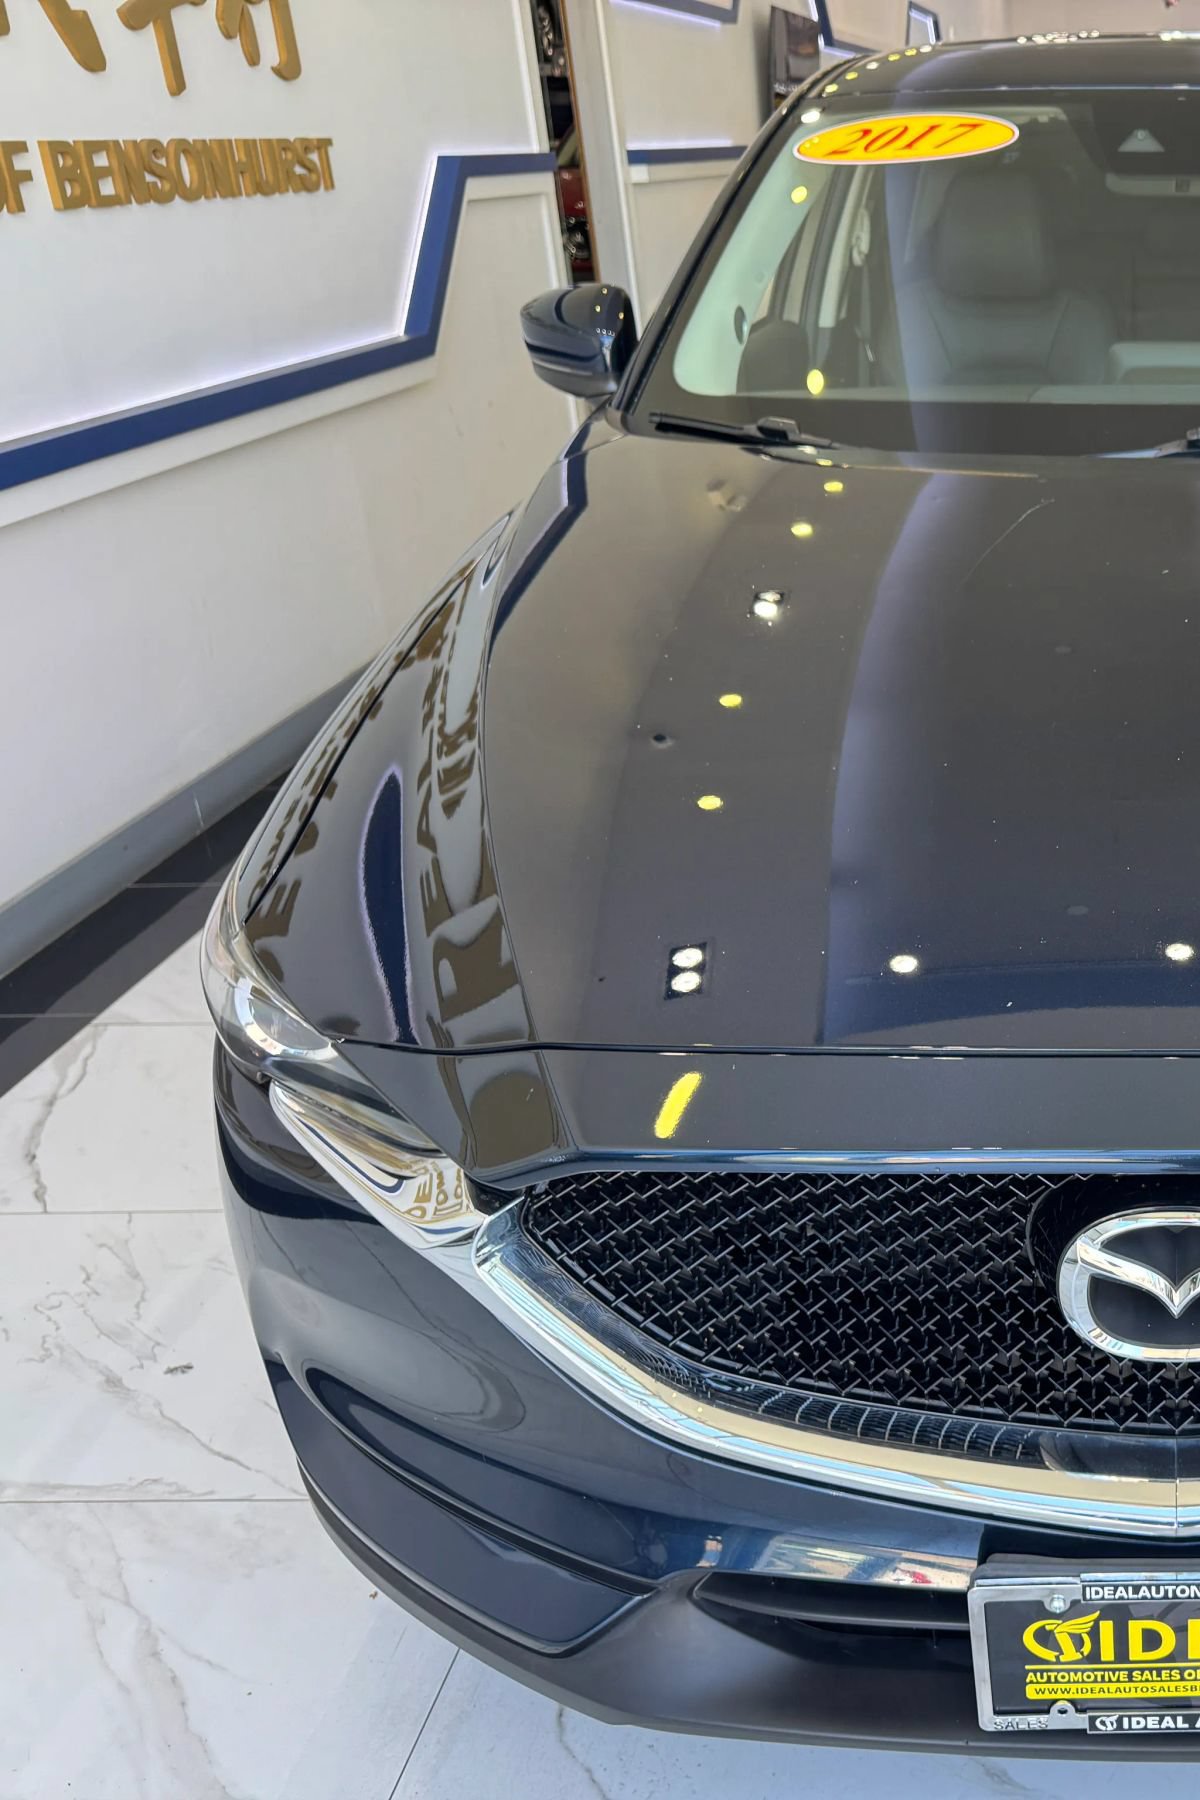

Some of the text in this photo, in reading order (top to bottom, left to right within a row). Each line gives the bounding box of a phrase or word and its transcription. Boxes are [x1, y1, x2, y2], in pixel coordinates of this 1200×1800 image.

[822, 122, 985, 157] 2017
[0, 138, 335, 214] F BENSONHURST
[1025, 1670, 1129, 1683] AUTOMOTIVE
[1132, 1669, 1181, 1682] SALES
[993, 1717, 1049, 1730] SALES
[1122, 1716, 1189, 1730] IDEAL
